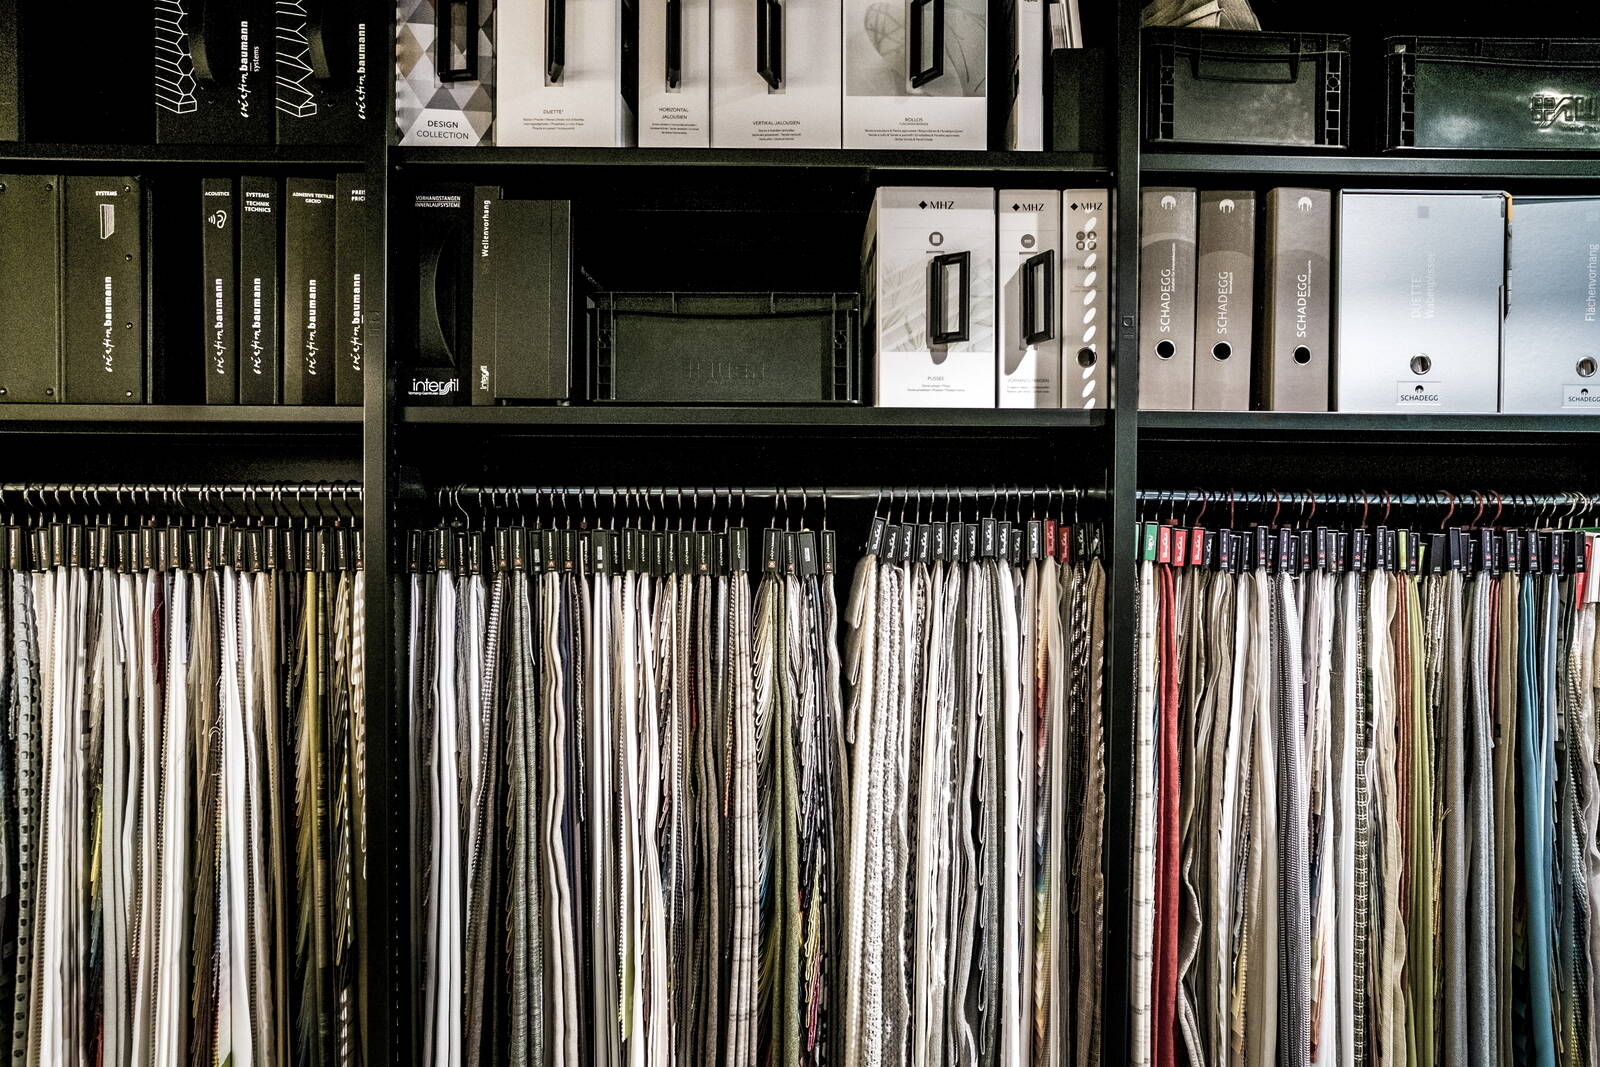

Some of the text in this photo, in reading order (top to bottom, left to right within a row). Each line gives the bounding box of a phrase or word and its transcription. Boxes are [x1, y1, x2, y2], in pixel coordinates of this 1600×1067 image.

[253, 46, 261, 72] systems
[427, 119, 459, 129] DESIGN
[416, 130, 469, 140] COLLECTION
[929, 200, 954, 210] MHZ
[1022, 203, 1045, 212] MHZ
[1080, 202, 1104, 211] MHZ
[481, 200, 491, 258] Wellenvorhang
[1584, 243, 1599, 322] Flächenvorhang
[1160, 268, 1171, 333] SCHADEGG
[1217, 271, 1229, 335] SCHADEGG
[1296, 273, 1307, 338] SCHADEGG
[412, 378, 459, 395] interstil
[1400, 394, 1439, 402] SCHADEGG
